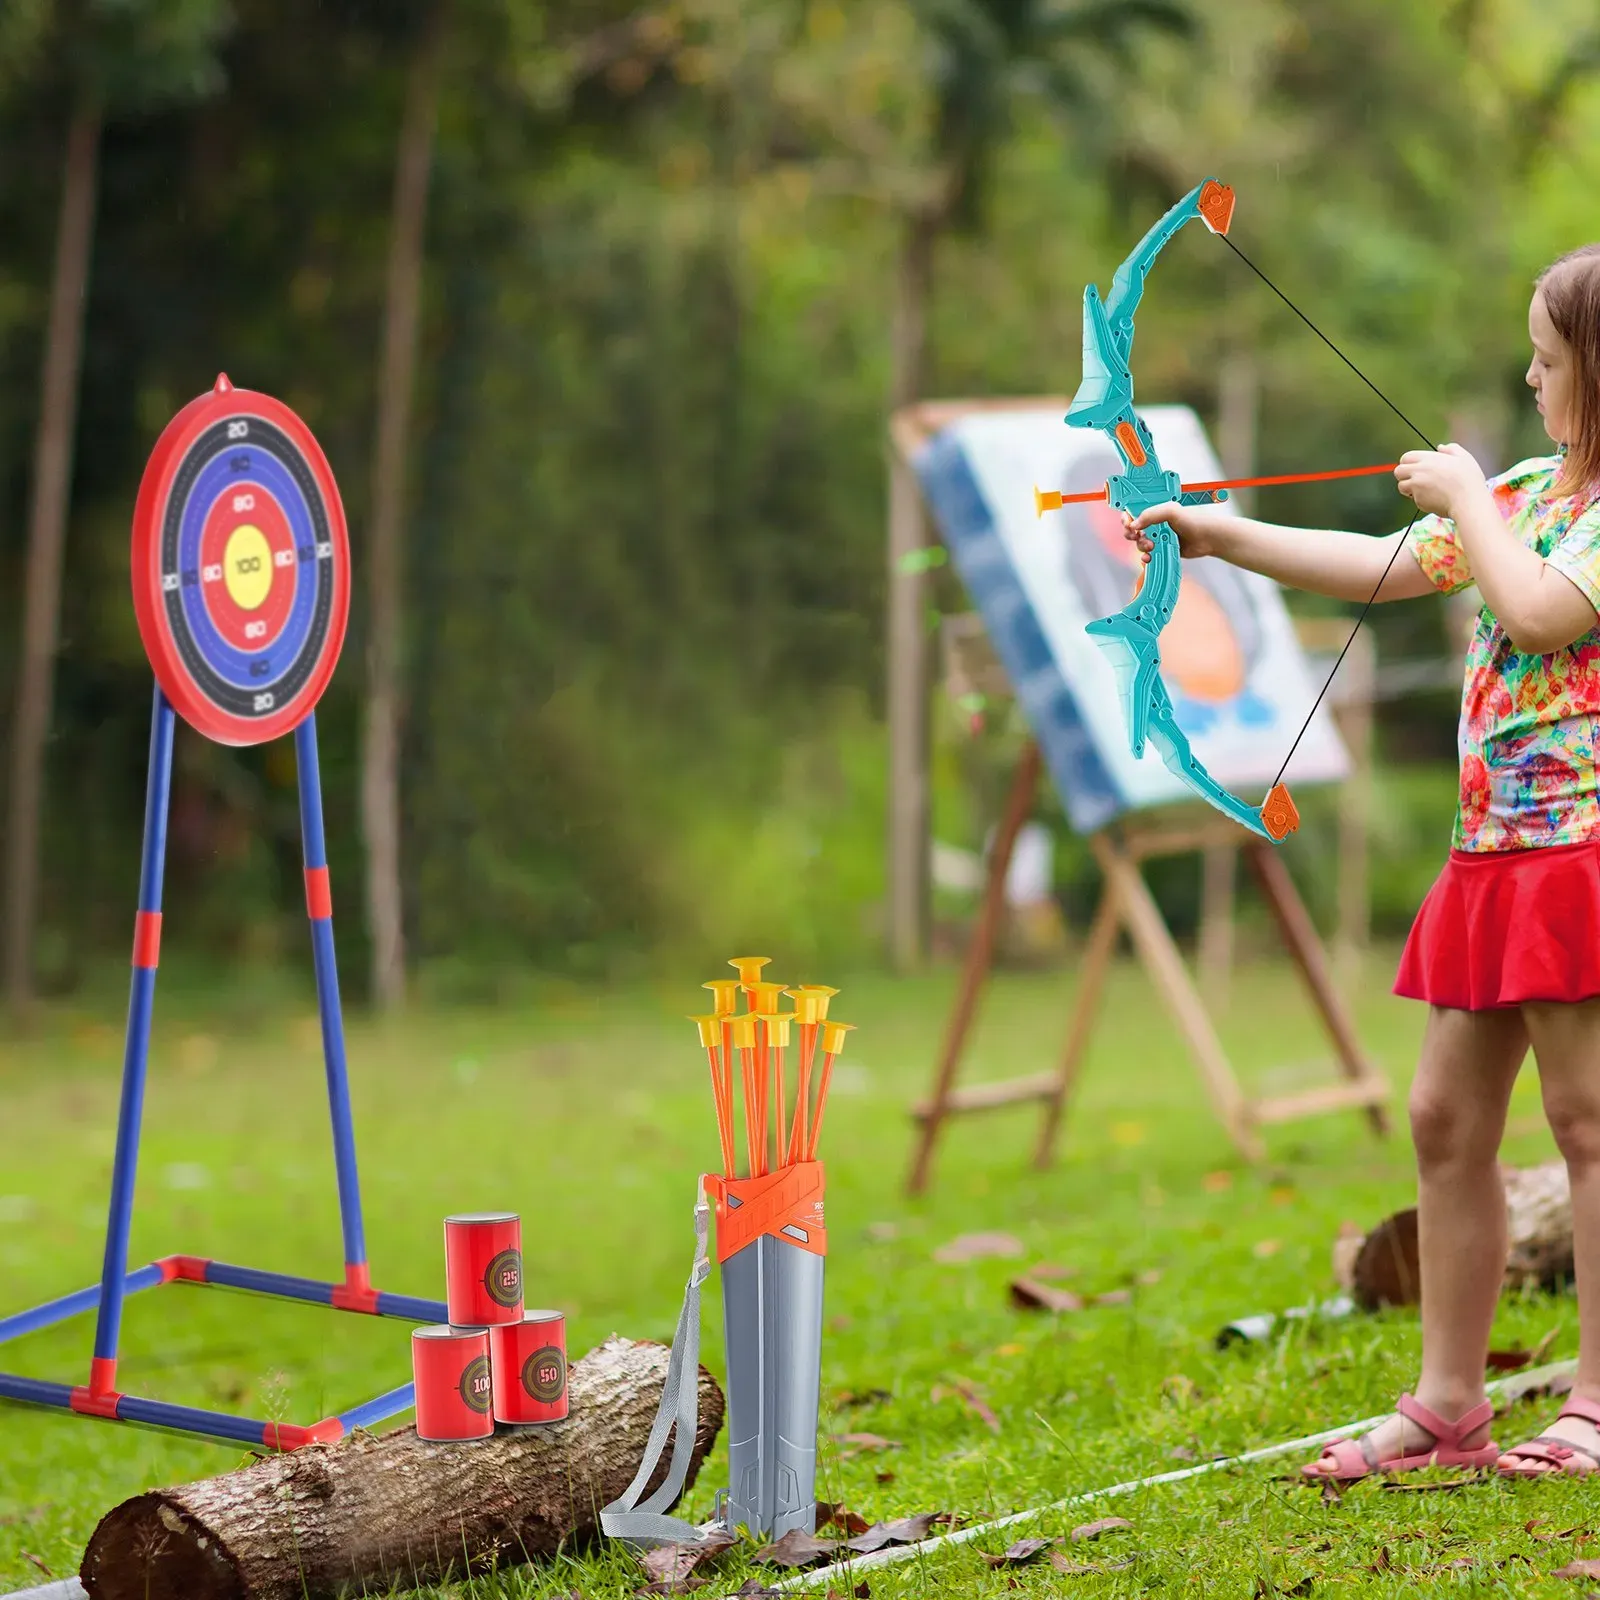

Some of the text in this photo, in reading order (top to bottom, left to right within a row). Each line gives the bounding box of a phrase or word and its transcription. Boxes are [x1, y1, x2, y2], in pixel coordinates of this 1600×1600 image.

[228, 421, 248, 439] 20
[236, 556, 261, 574] 100
[254, 692, 274, 712] 20
[503, 1270, 517, 1286] 25
[540, 1367, 557, 1383] 50
[474, 1376, 491, 1393] 100
